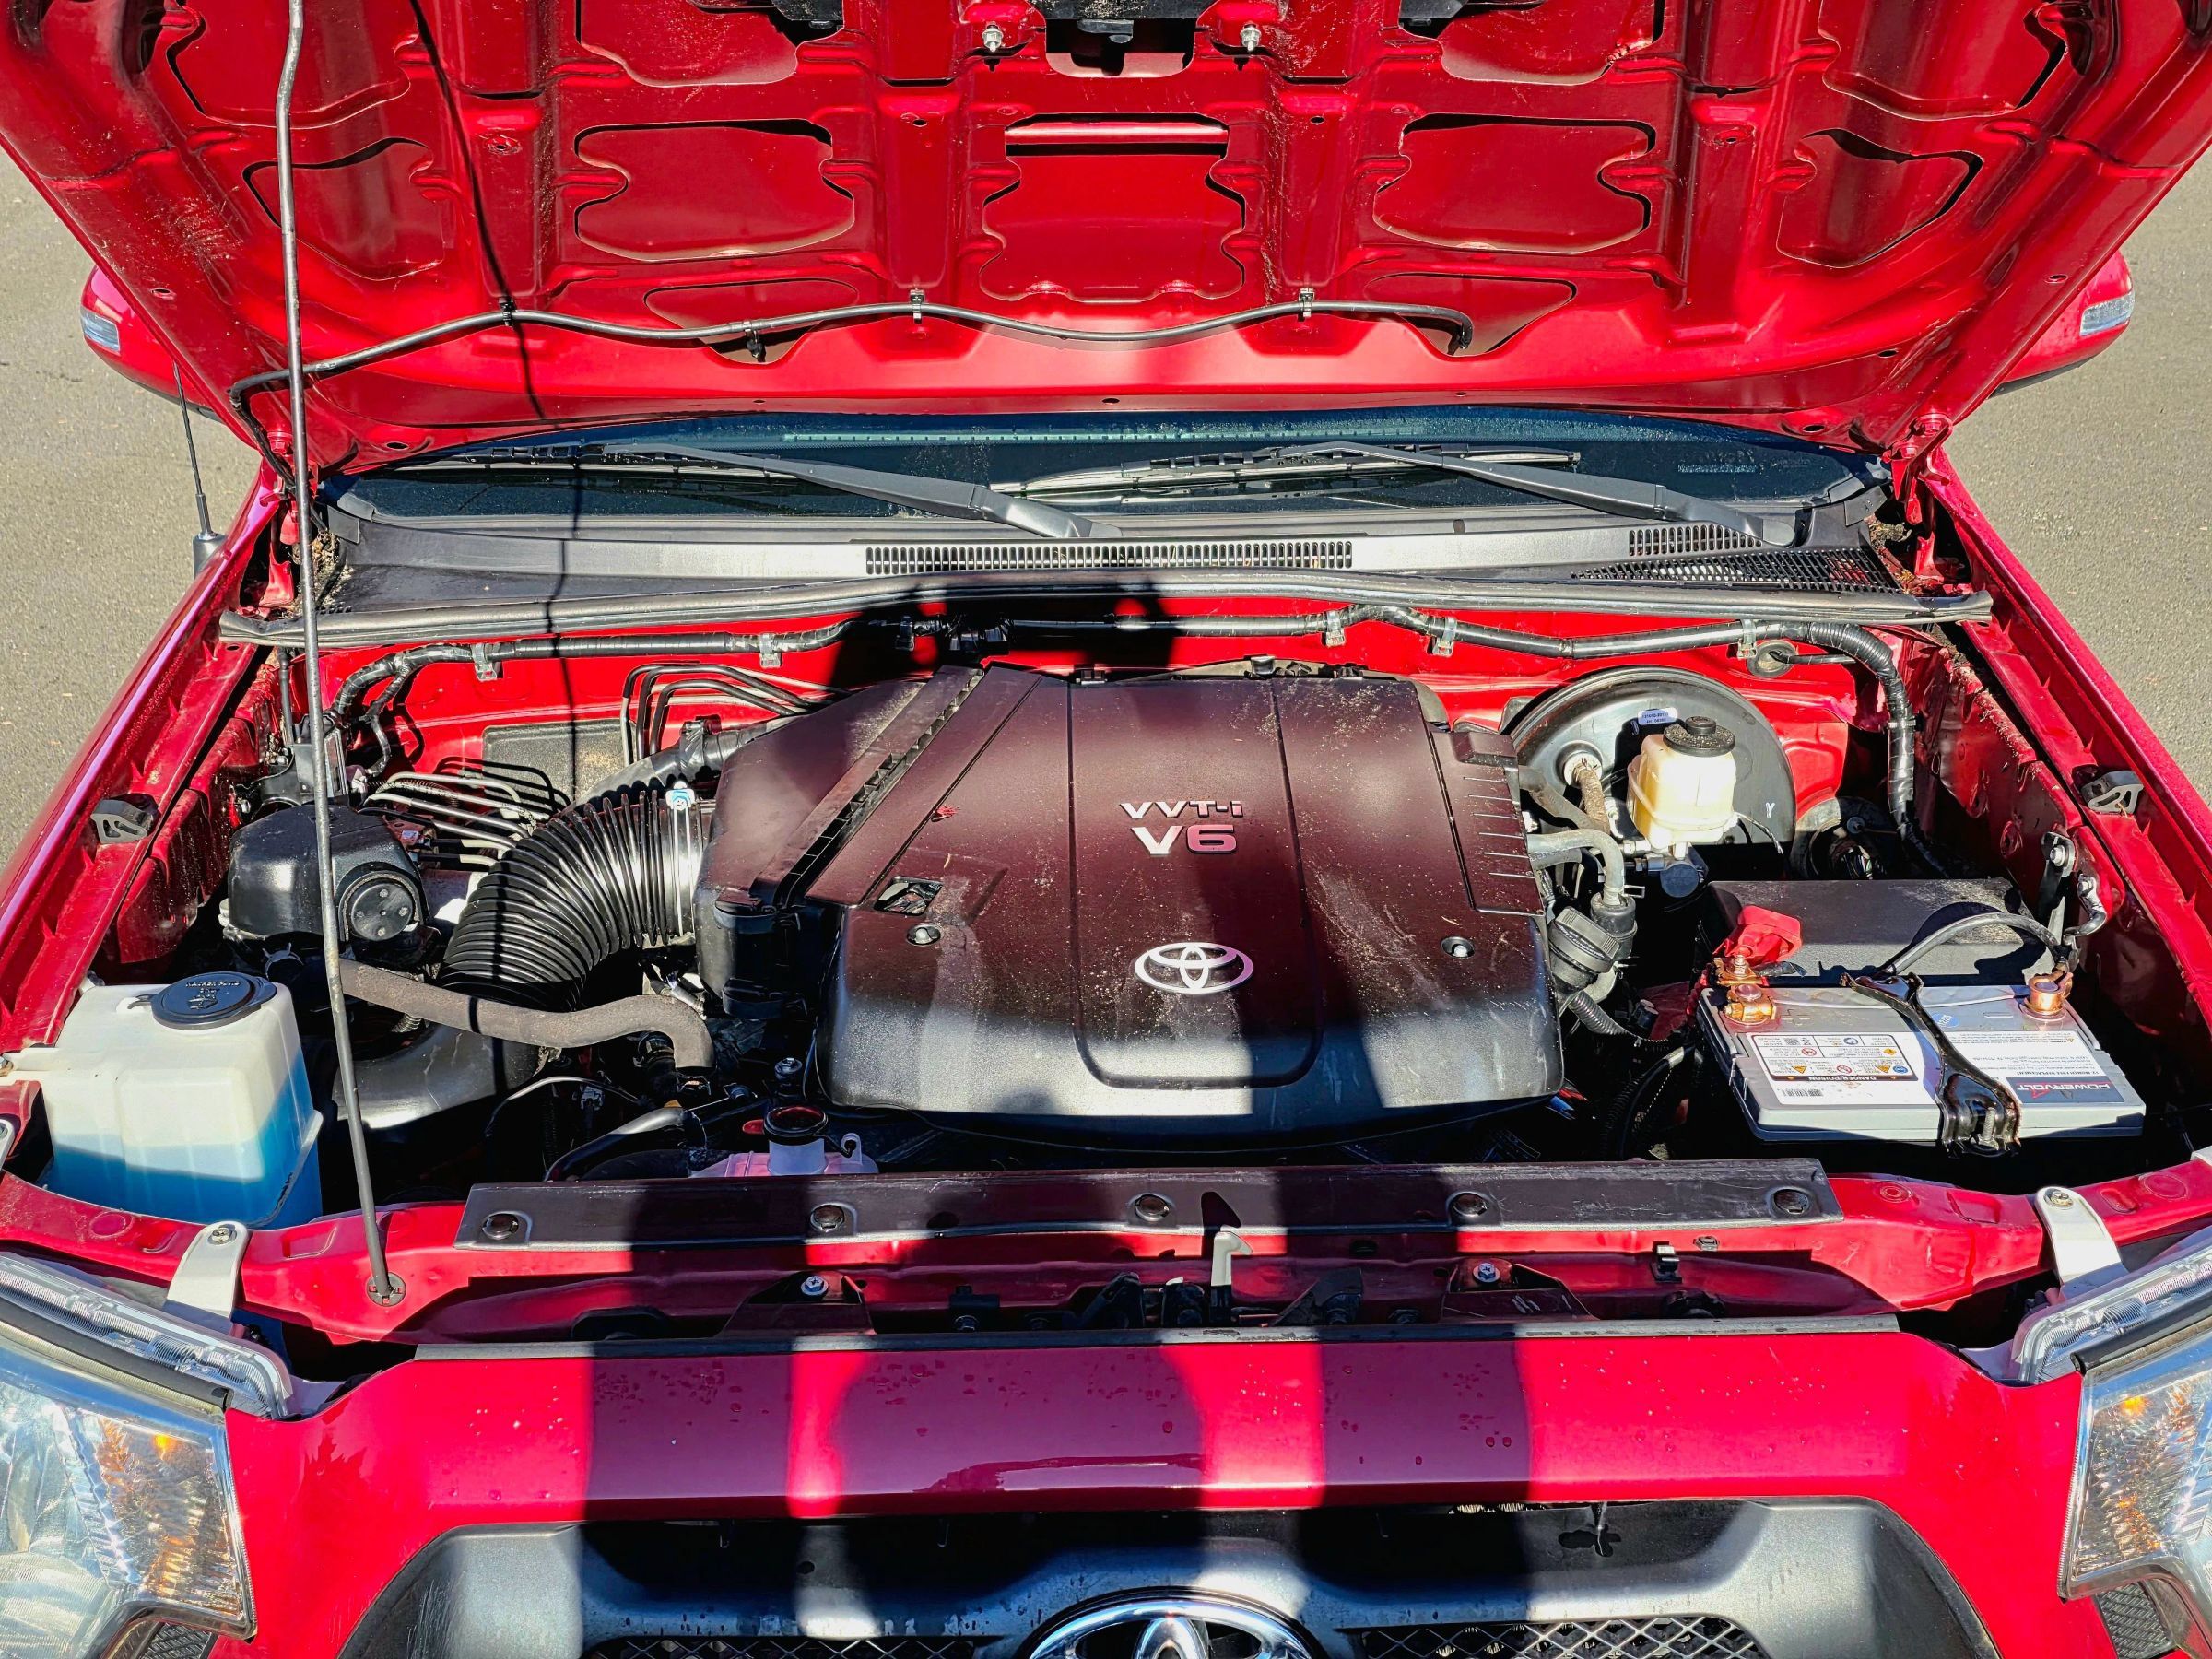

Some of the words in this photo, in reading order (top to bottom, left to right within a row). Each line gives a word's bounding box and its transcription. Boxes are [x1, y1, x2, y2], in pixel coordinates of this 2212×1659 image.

[1119, 800, 1244, 819] VVT-i
[1131, 824, 1238, 856] V6
[2018, 1083, 2111, 1091] POWERVOLT
